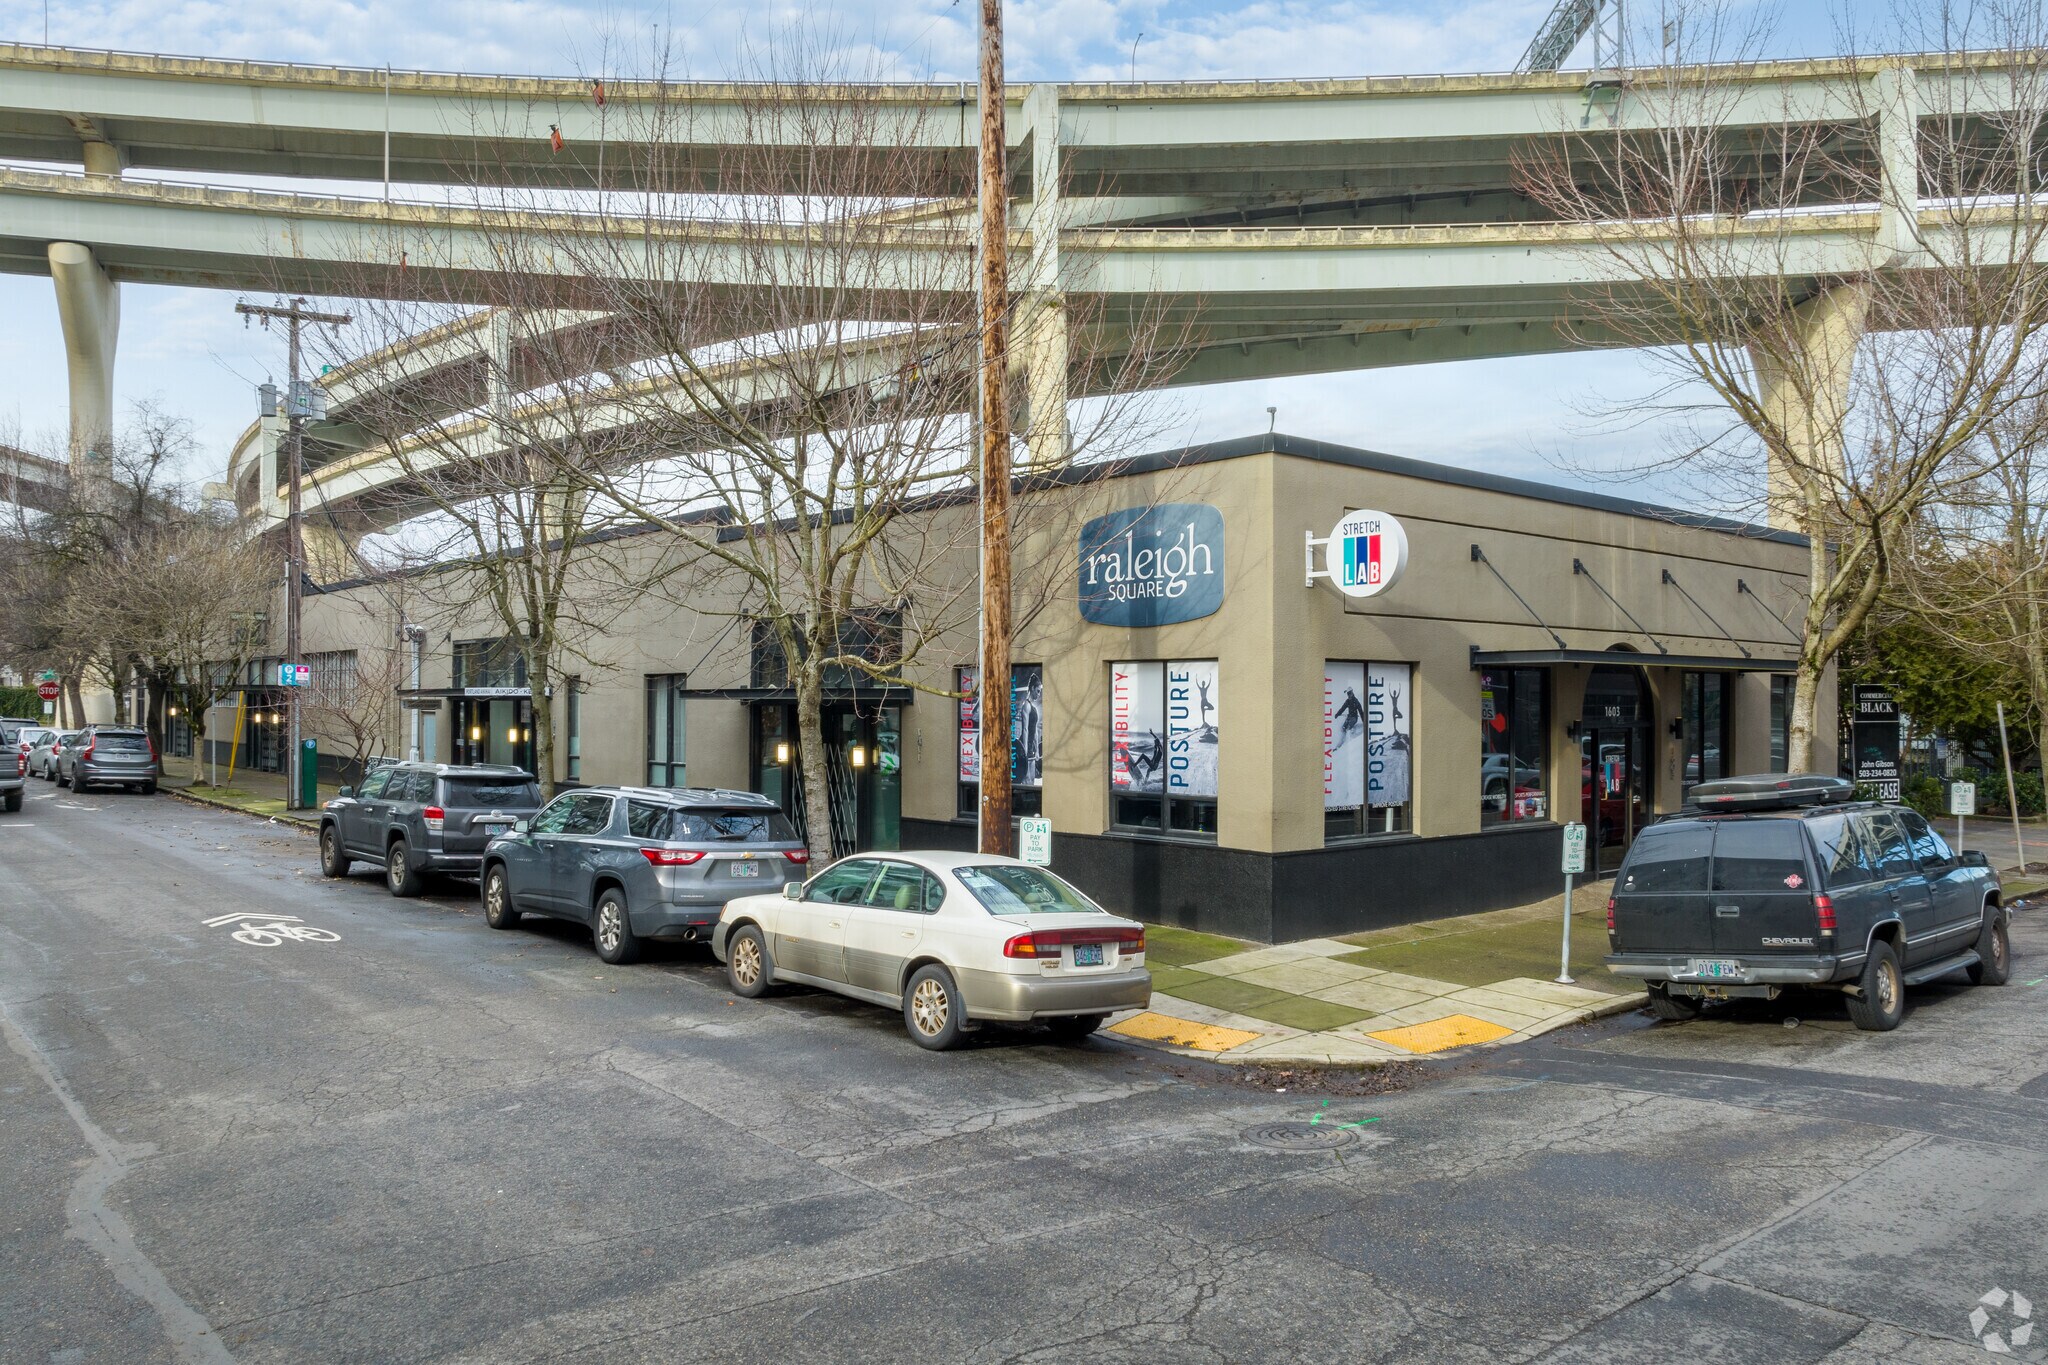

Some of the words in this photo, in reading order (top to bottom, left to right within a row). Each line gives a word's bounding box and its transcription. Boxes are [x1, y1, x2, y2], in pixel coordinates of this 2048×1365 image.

[1343, 520, 1381, 535] STRETCH
[1086, 522, 1214, 598] raleigh
[1344, 561, 1380, 584] LAB
[1108, 580, 1164, 603] SQUARE
[286, 674, 293, 683] 2
[39, 687, 60, 695] STOP
[1604, 706, 1621, 717] 1603
[1860, 702, 1894, 713] BLACK
[961, 675, 974, 777] FLEXIBILITY
[1112, 671, 1130, 786] FLEXIBILITY
[1169, 670, 1190, 788] POSTURE
[1368, 675, 1385, 792] POSTURE
[1861, 760, 1875, 768] John
[1875, 760, 1894, 768] Gibson
[1858, 768, 1897, 778] 503-234-0820
[1761, 937, 1813, 945] CHEVROLET
[1698, 963, 1714, 975] 014
[1718, 963, 1734, 974] FEW
